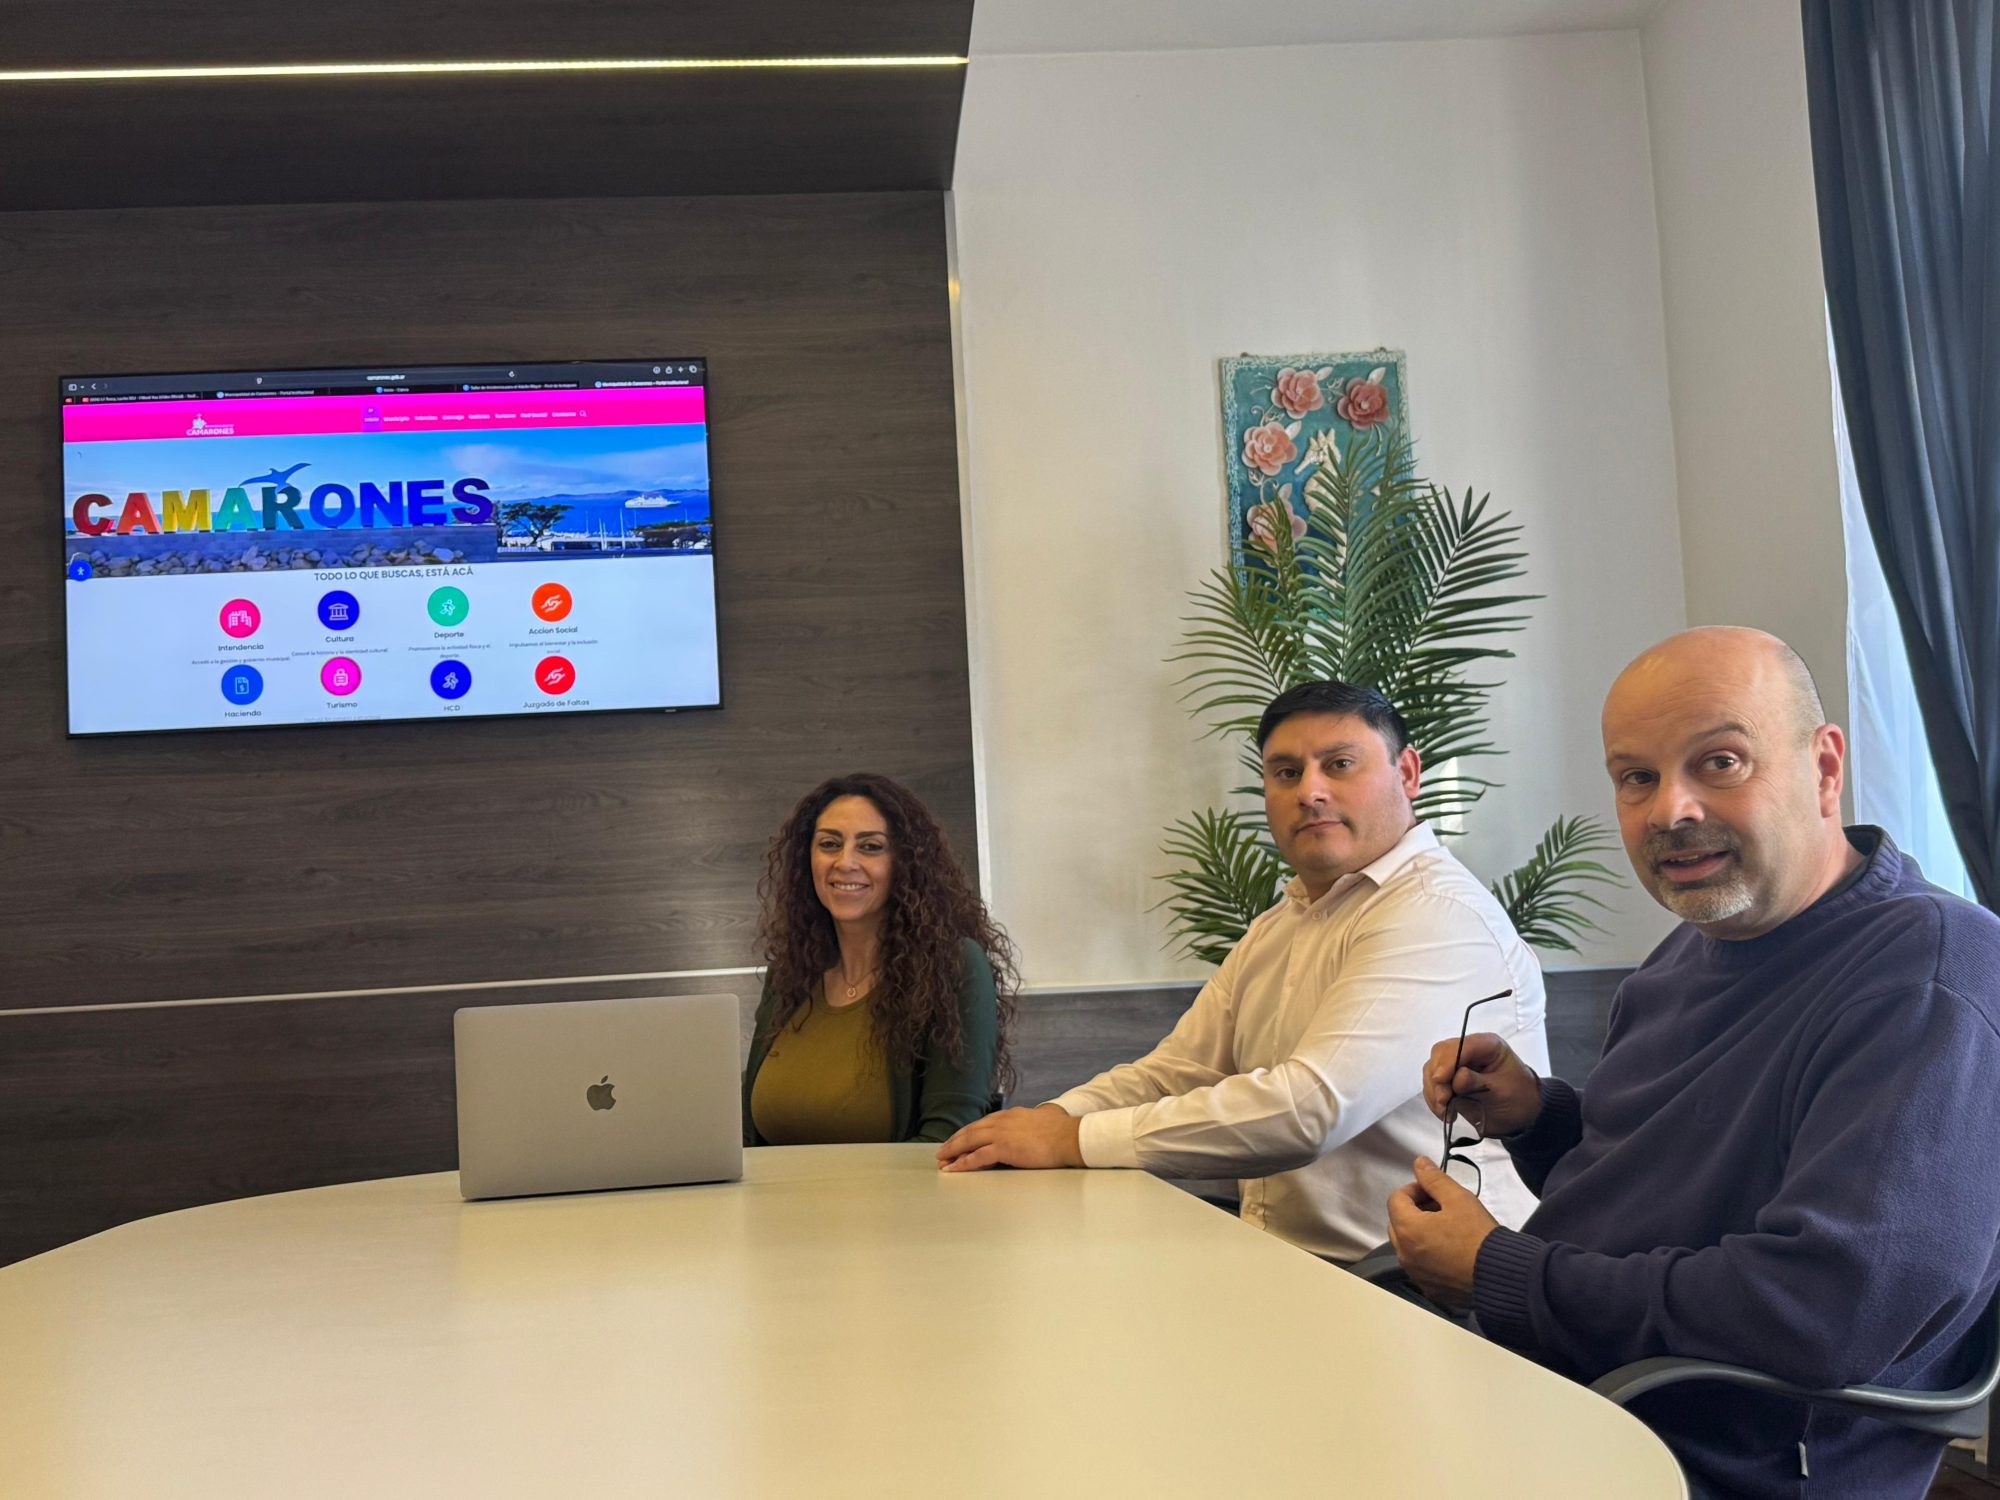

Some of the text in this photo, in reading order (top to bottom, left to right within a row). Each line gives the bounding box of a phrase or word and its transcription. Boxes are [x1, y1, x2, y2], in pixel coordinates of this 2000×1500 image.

[186, 428, 234, 436] CAMARONES
[72, 477, 494, 536] CAMARONES
[314, 566, 474, 581] TODO LO QUE BUSCAS, ESTÁ ACÁ
[218, 644, 264, 652] Intendencia
[522, 700, 556, 710] Juzgado
